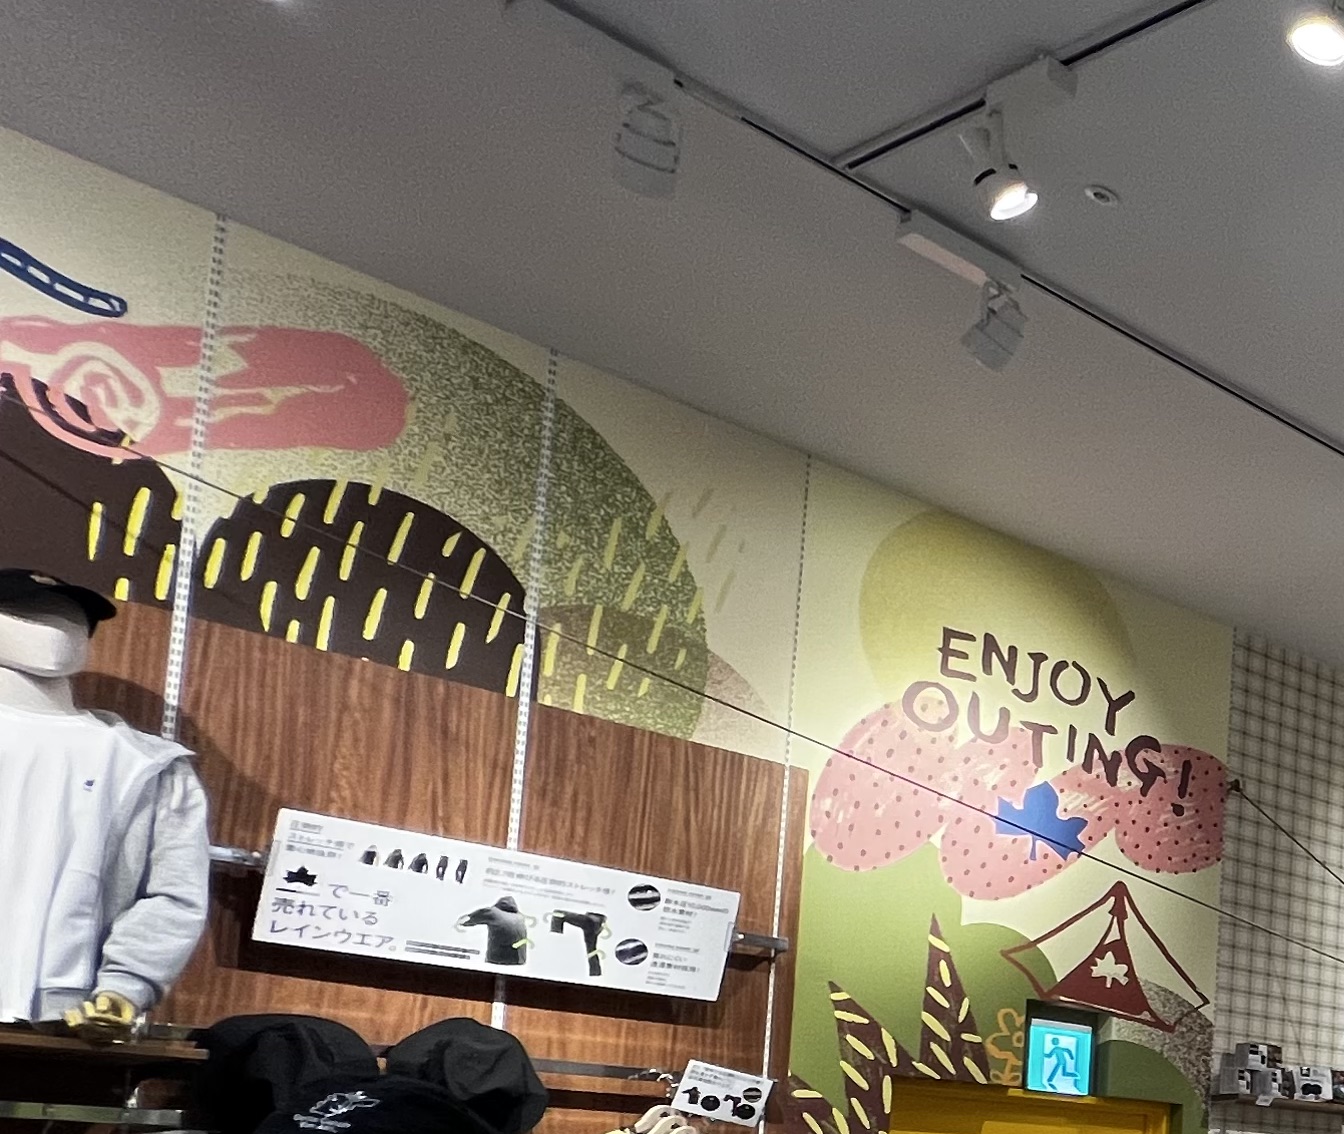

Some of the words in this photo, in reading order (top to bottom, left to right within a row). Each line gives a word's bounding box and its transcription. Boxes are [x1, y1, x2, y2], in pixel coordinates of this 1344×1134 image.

[938, 626, 1136, 736] ENJOY
[902, 680, 1192, 817] OUTING!
[271, 897, 379, 926] 売れている
[328, 882, 394, 907] で一番
